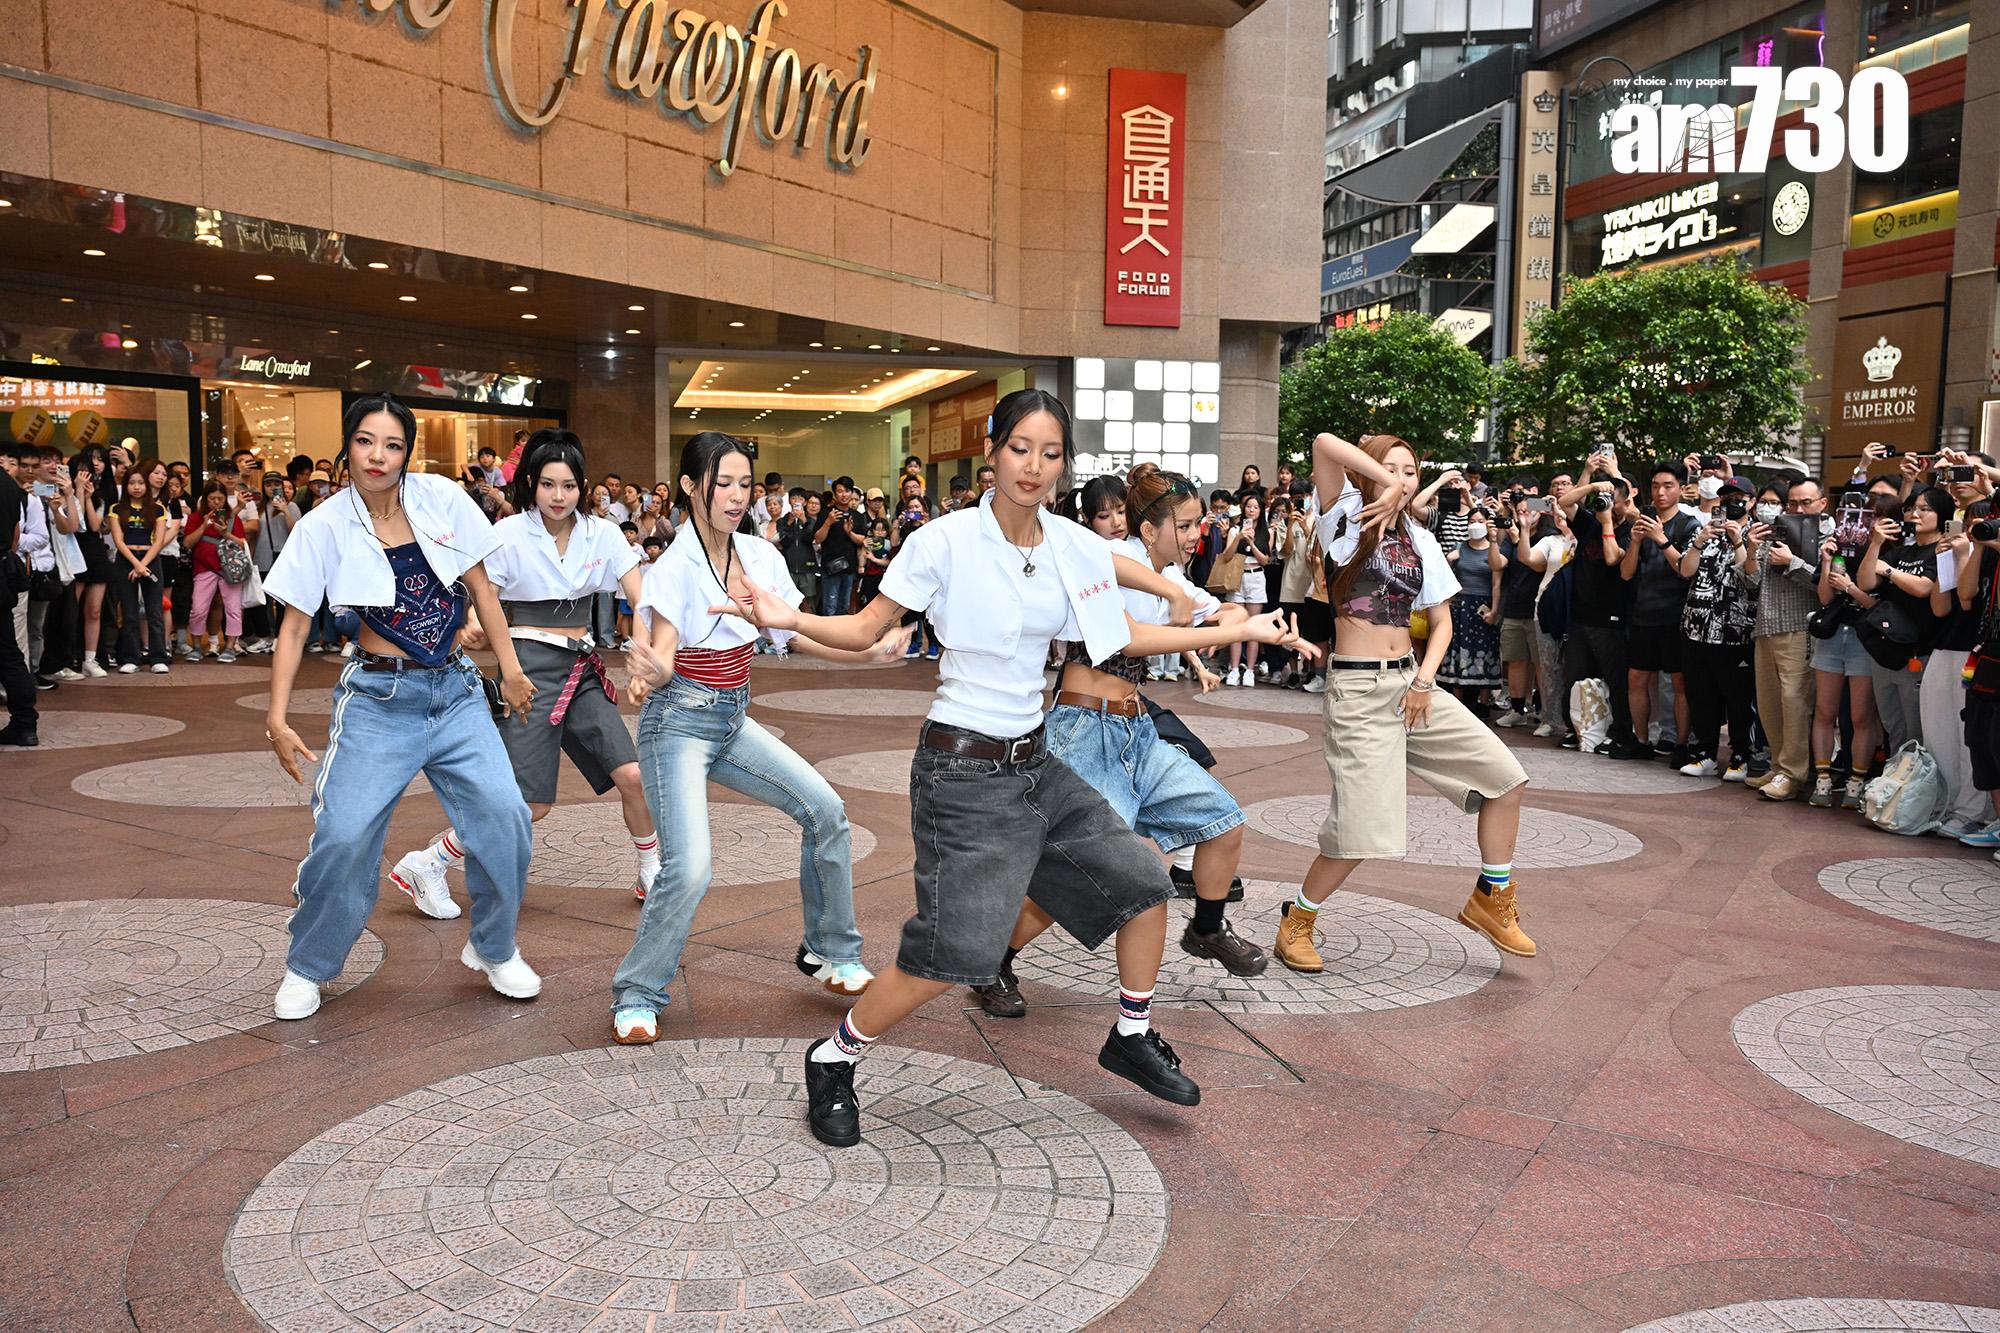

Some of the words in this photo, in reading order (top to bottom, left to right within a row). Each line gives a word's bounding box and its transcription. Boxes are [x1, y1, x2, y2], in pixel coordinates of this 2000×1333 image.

[1119, 103, 1175, 257] 食通天
[1117, 271, 1170, 283] FOOD
[1117, 284, 1170, 296] FORUM
[240, 355, 265, 371] Lane
[265, 356, 312, 379] Crawford
[1842, 400, 1916, 420] EMPEROR
[411, 616, 440, 631] COWBOY
